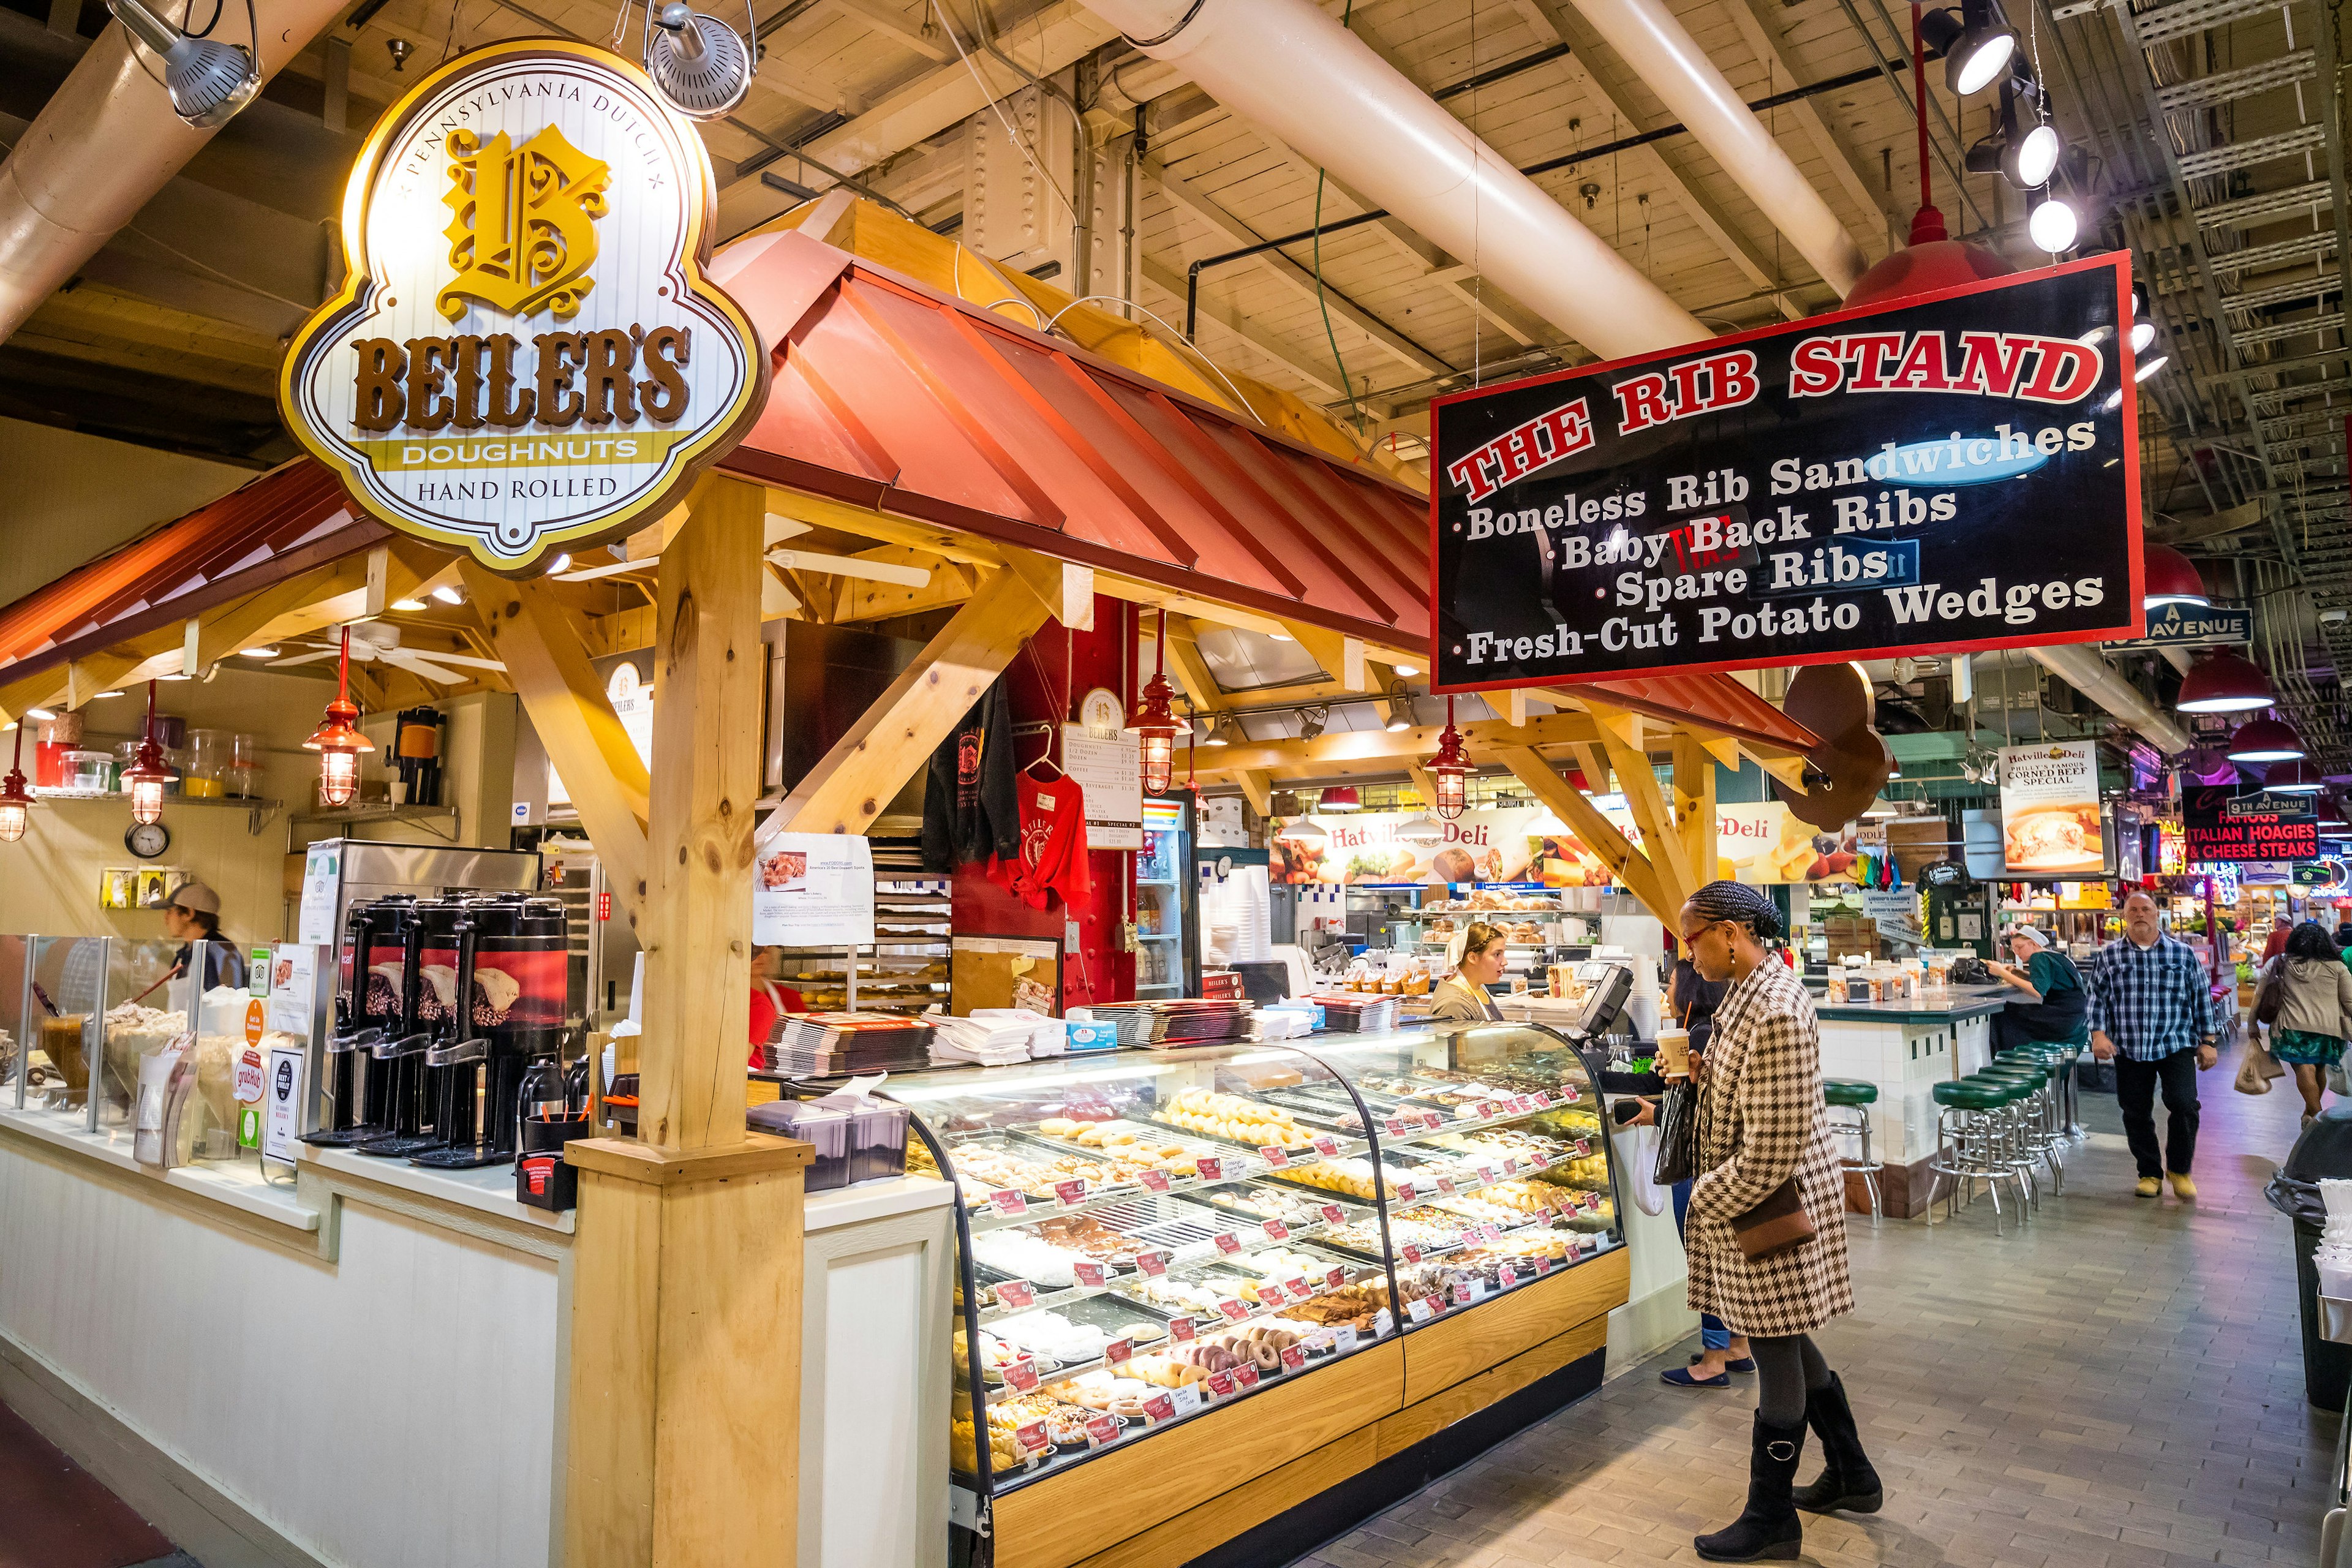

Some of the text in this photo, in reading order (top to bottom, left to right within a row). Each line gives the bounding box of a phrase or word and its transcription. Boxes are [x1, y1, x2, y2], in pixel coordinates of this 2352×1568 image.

[407, 80, 662, 175] PENNSYLVANIA DUTCH
[436, 122, 612, 321] B
[350, 323, 692, 434] BEILER'S
[1447, 331, 2104, 505] THE RIB STAND
[402, 439, 638, 466] DOUGHNUTS
[417, 477, 617, 502] HAND ROLLED
[1467, 421, 2097, 540] Boneless Rib Sandwiches
[1561, 488, 1958, 570] Baby Back Ribs
[1616, 565, 1748, 612] Spare
[1770, 545, 1888, 589] Ribs
[1466, 616, 1679, 666] Fresh-Cut
[1698, 597, 1861, 644] Potato
[1884, 576, 2105, 626] Wedges
[2150, 618, 2244, 638] AVENUE
[1069, 742, 1102, 750] DOUGHNUTS
[2008, 750, 2085, 764] Hatville Deli
[2007, 766, 2088, 780] CORNED BEEF
[2023, 776, 2074, 786] SPECIAL
[2256, 800, 2306, 810] AVENUE
[1442, 822, 1488, 846] Deli
[1722, 817, 1768, 839] Deli
[2187, 824, 2316, 843] ITALIAN HOAGIES
[2190, 846, 2199, 858] &
[2203, 843, 2257, 859] CHEESE
[2260, 842, 2317, 858] STEAKS
[277, 1081, 290, 1090] PHILLY
[278, 1074, 287, 1082] BEST
[1058, 1183, 1074, 1191] Caramel
[1175, 1389, 1187, 1398] Vanilla
